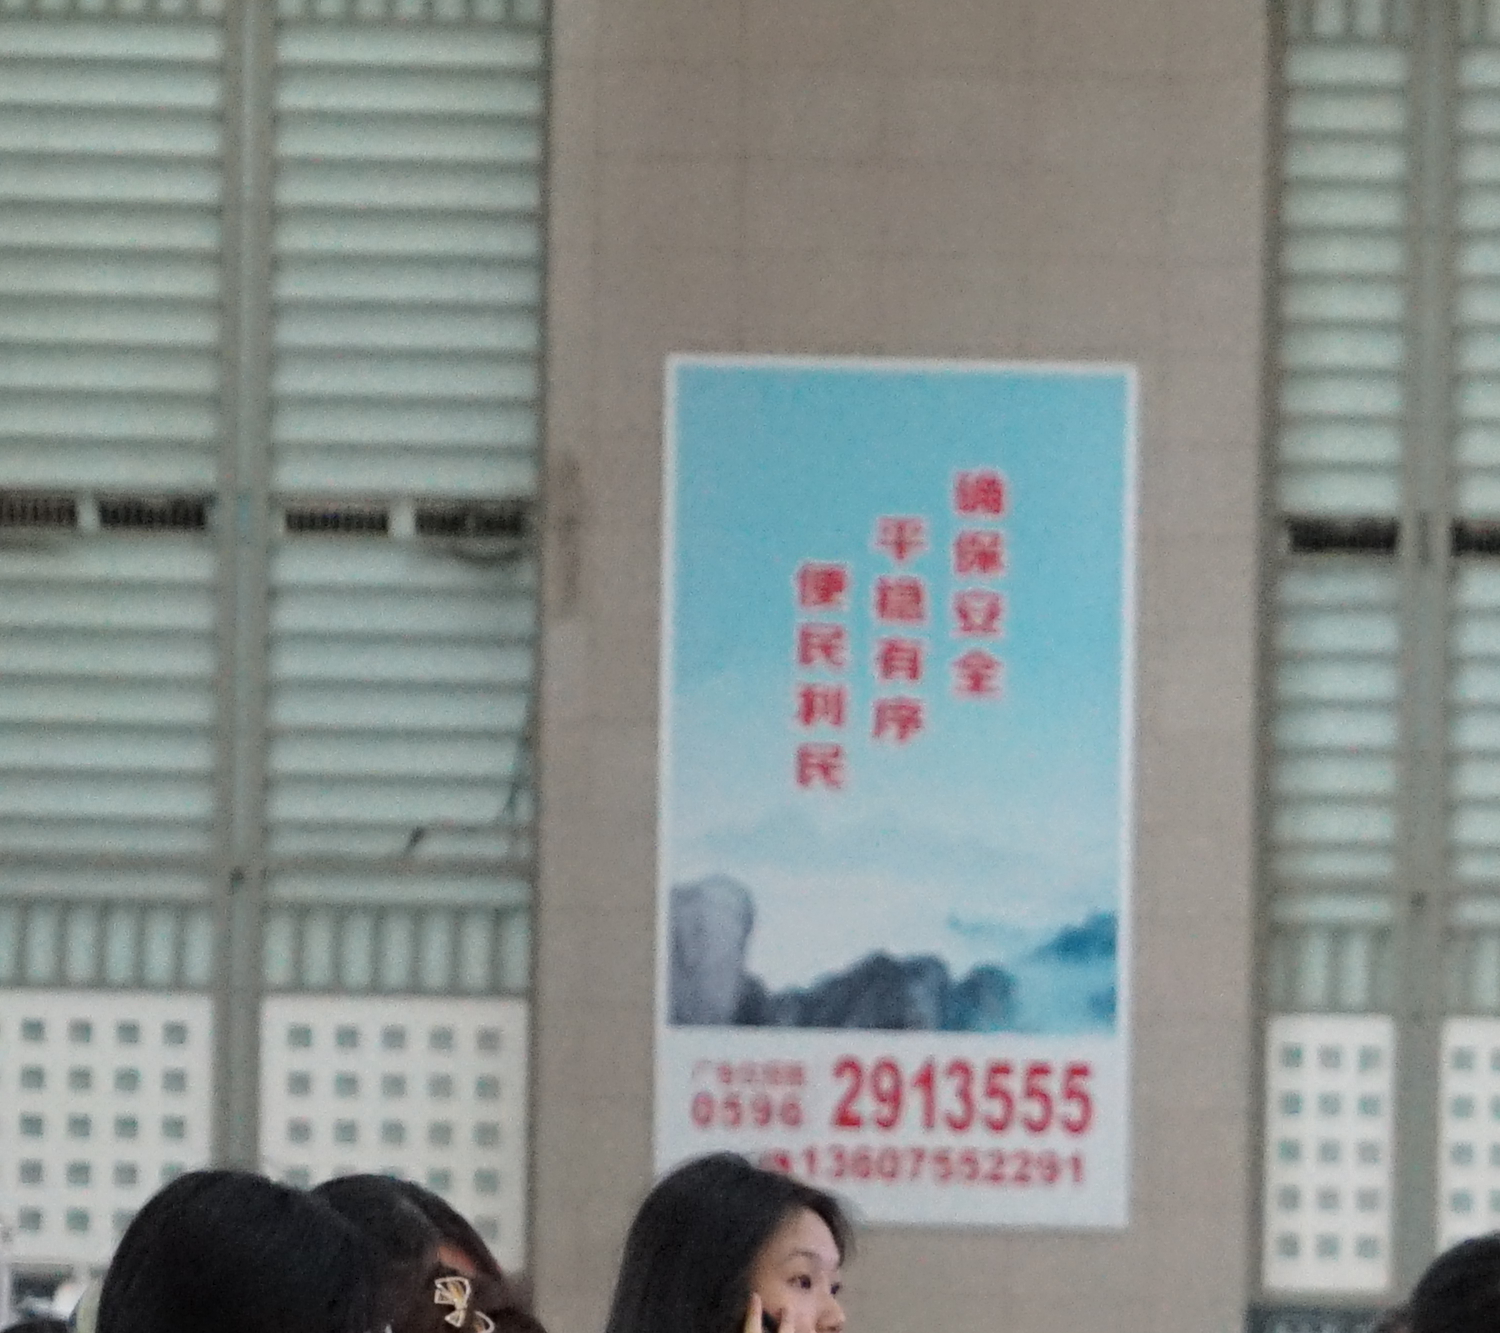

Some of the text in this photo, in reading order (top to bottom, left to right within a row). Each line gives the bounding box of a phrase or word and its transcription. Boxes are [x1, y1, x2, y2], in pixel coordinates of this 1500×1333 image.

[796, 562, 846, 790] 便民利民
[873, 516, 926, 743] 平稳有序
[953, 469, 1004, 700] 确保安全
[692, 1093, 803, 1128] 0596
[832, 1054, 1094, 1134] 2913555
